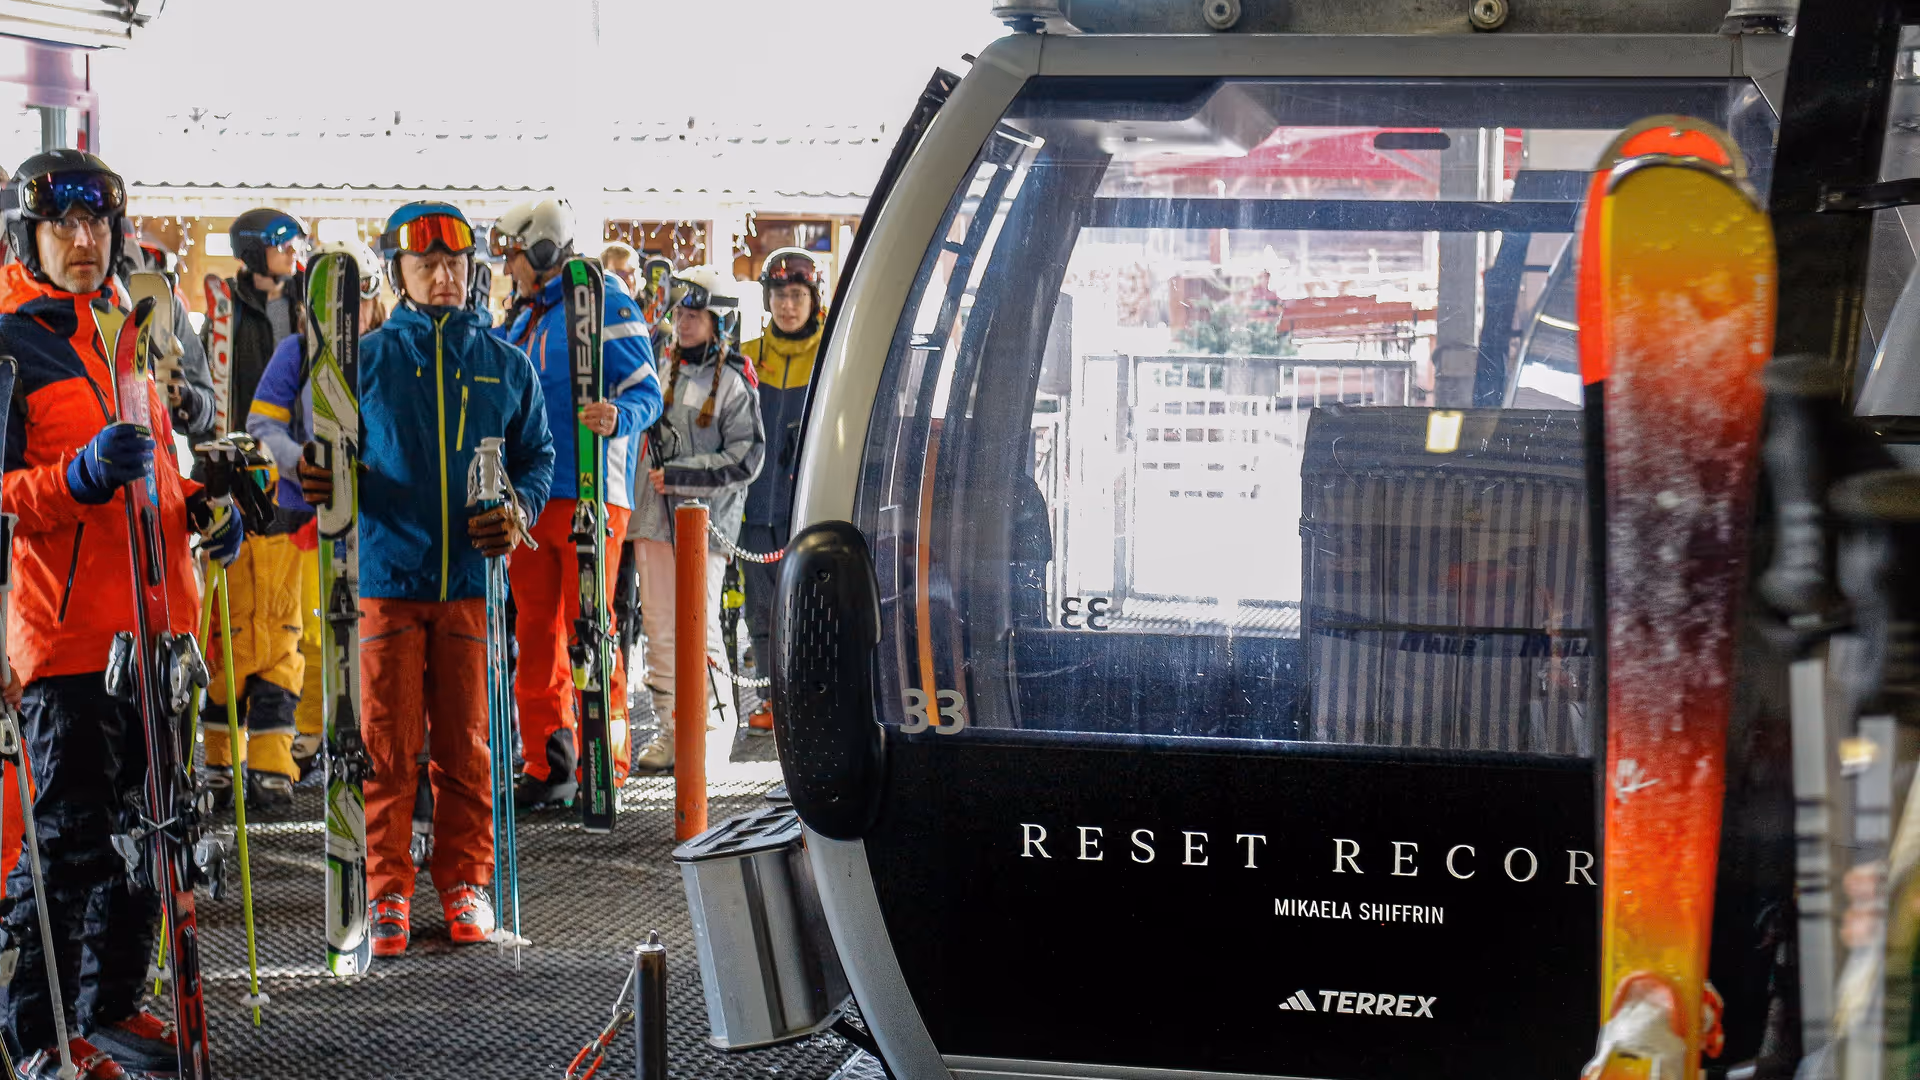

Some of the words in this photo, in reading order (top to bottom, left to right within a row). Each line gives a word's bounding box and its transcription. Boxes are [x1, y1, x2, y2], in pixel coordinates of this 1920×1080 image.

[207, 279, 231, 437] ATOMI
[344, 312, 352, 365] WAYBACK
[574, 284, 593, 405] HEAD
[900, 688, 965, 735] 33
[1020, 824, 1267, 868] RESET
[1274, 898, 1353, 919] MIKAELA
[1359, 902, 1444, 925] SHIFFRIN
[1319, 989, 1437, 1018] TERREX
